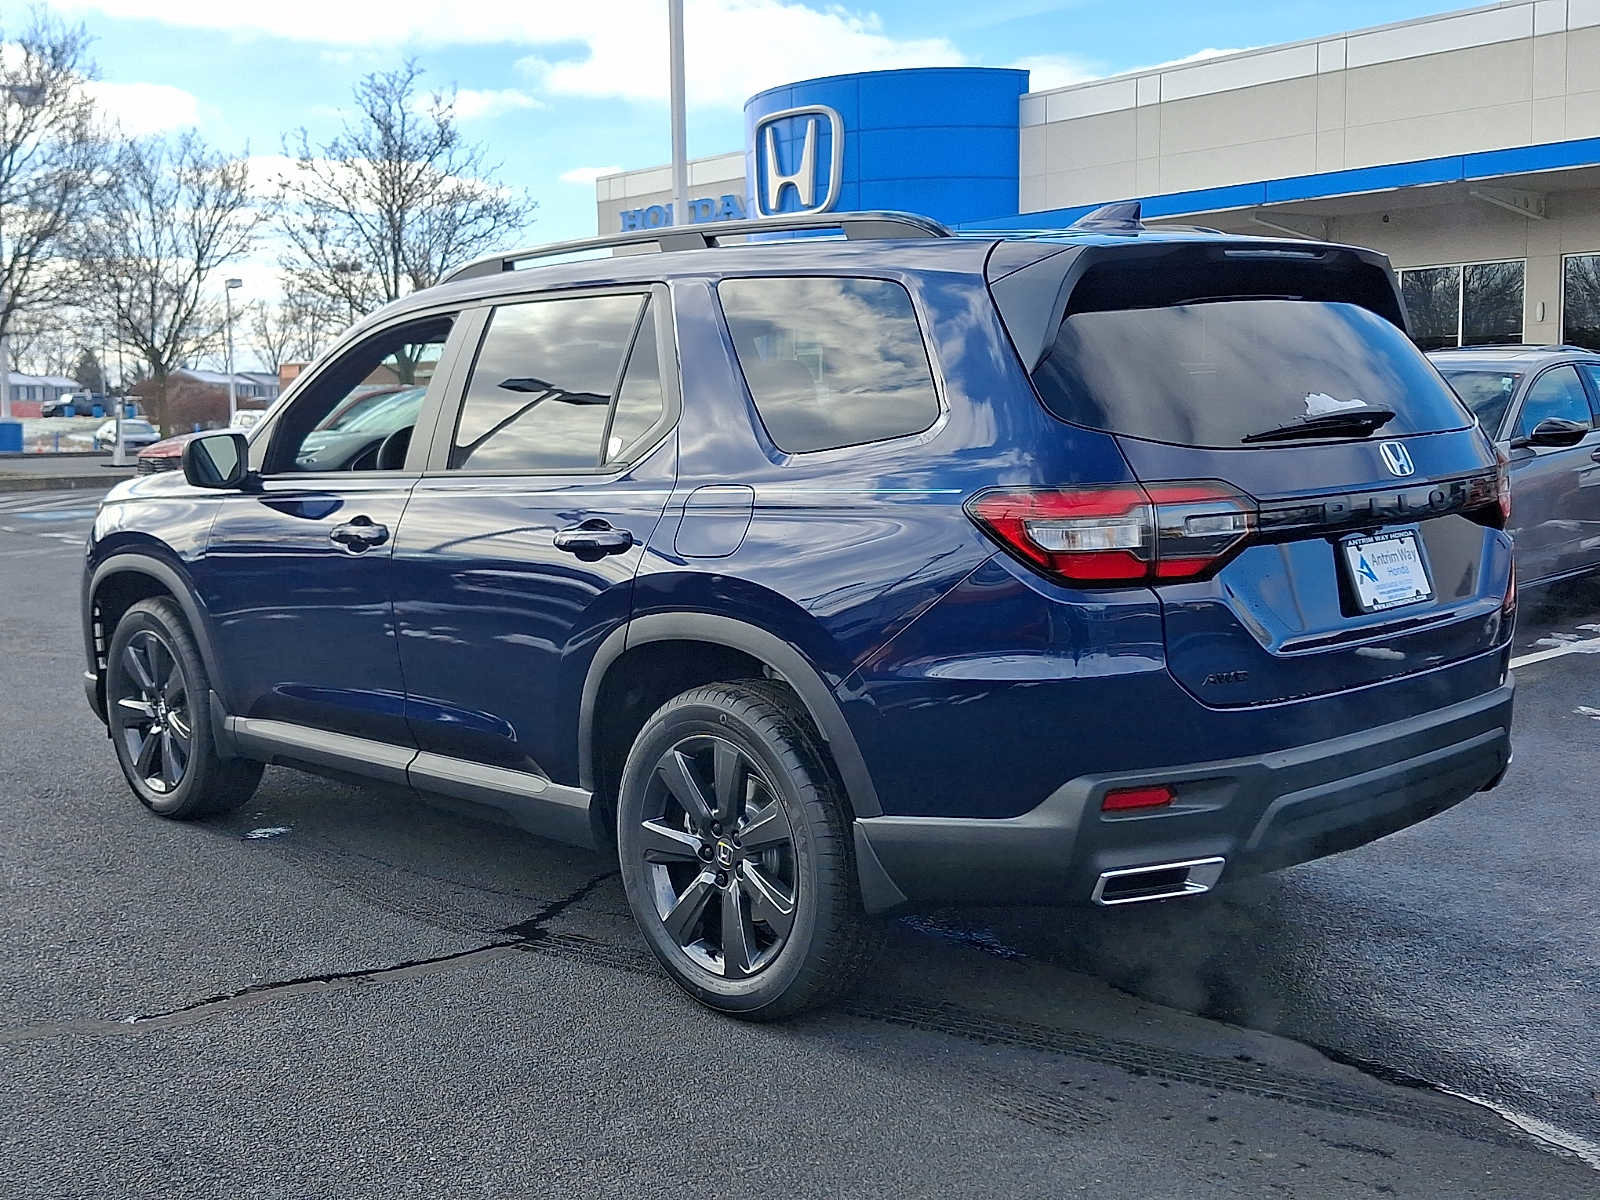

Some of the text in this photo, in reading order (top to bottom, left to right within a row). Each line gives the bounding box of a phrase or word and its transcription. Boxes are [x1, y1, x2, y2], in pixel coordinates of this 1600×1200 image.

[1348, 531, 1414, 546] ANTRIM WAY HONDA
[1372, 548, 1416, 566] Antrim Way
